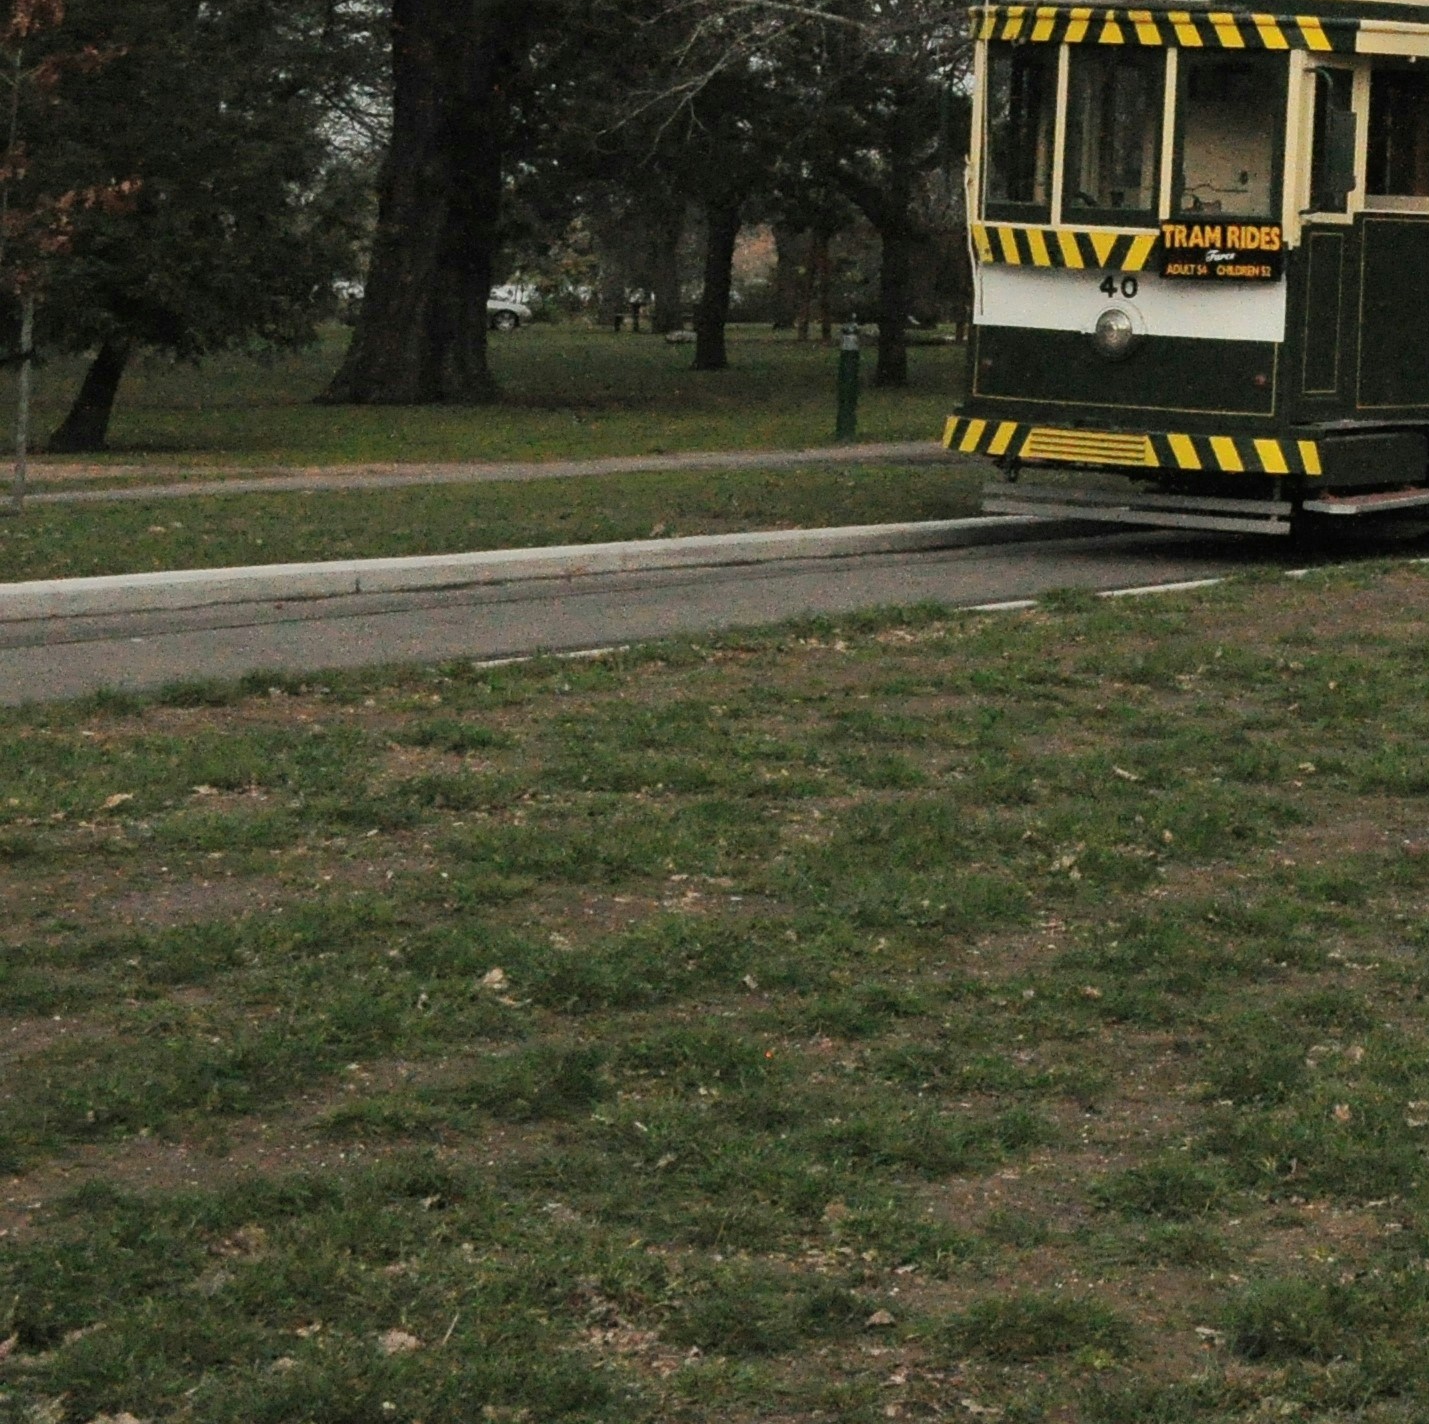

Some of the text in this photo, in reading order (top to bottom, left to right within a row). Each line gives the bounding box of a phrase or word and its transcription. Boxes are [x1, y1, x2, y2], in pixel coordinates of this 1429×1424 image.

[1162, 224, 1281, 252] TRAM RIDES
[1166, 264, 1195, 275] ADULT
[1216, 265, 1259, 277] CHILDREN
[1100, 277, 1139, 298] 40
